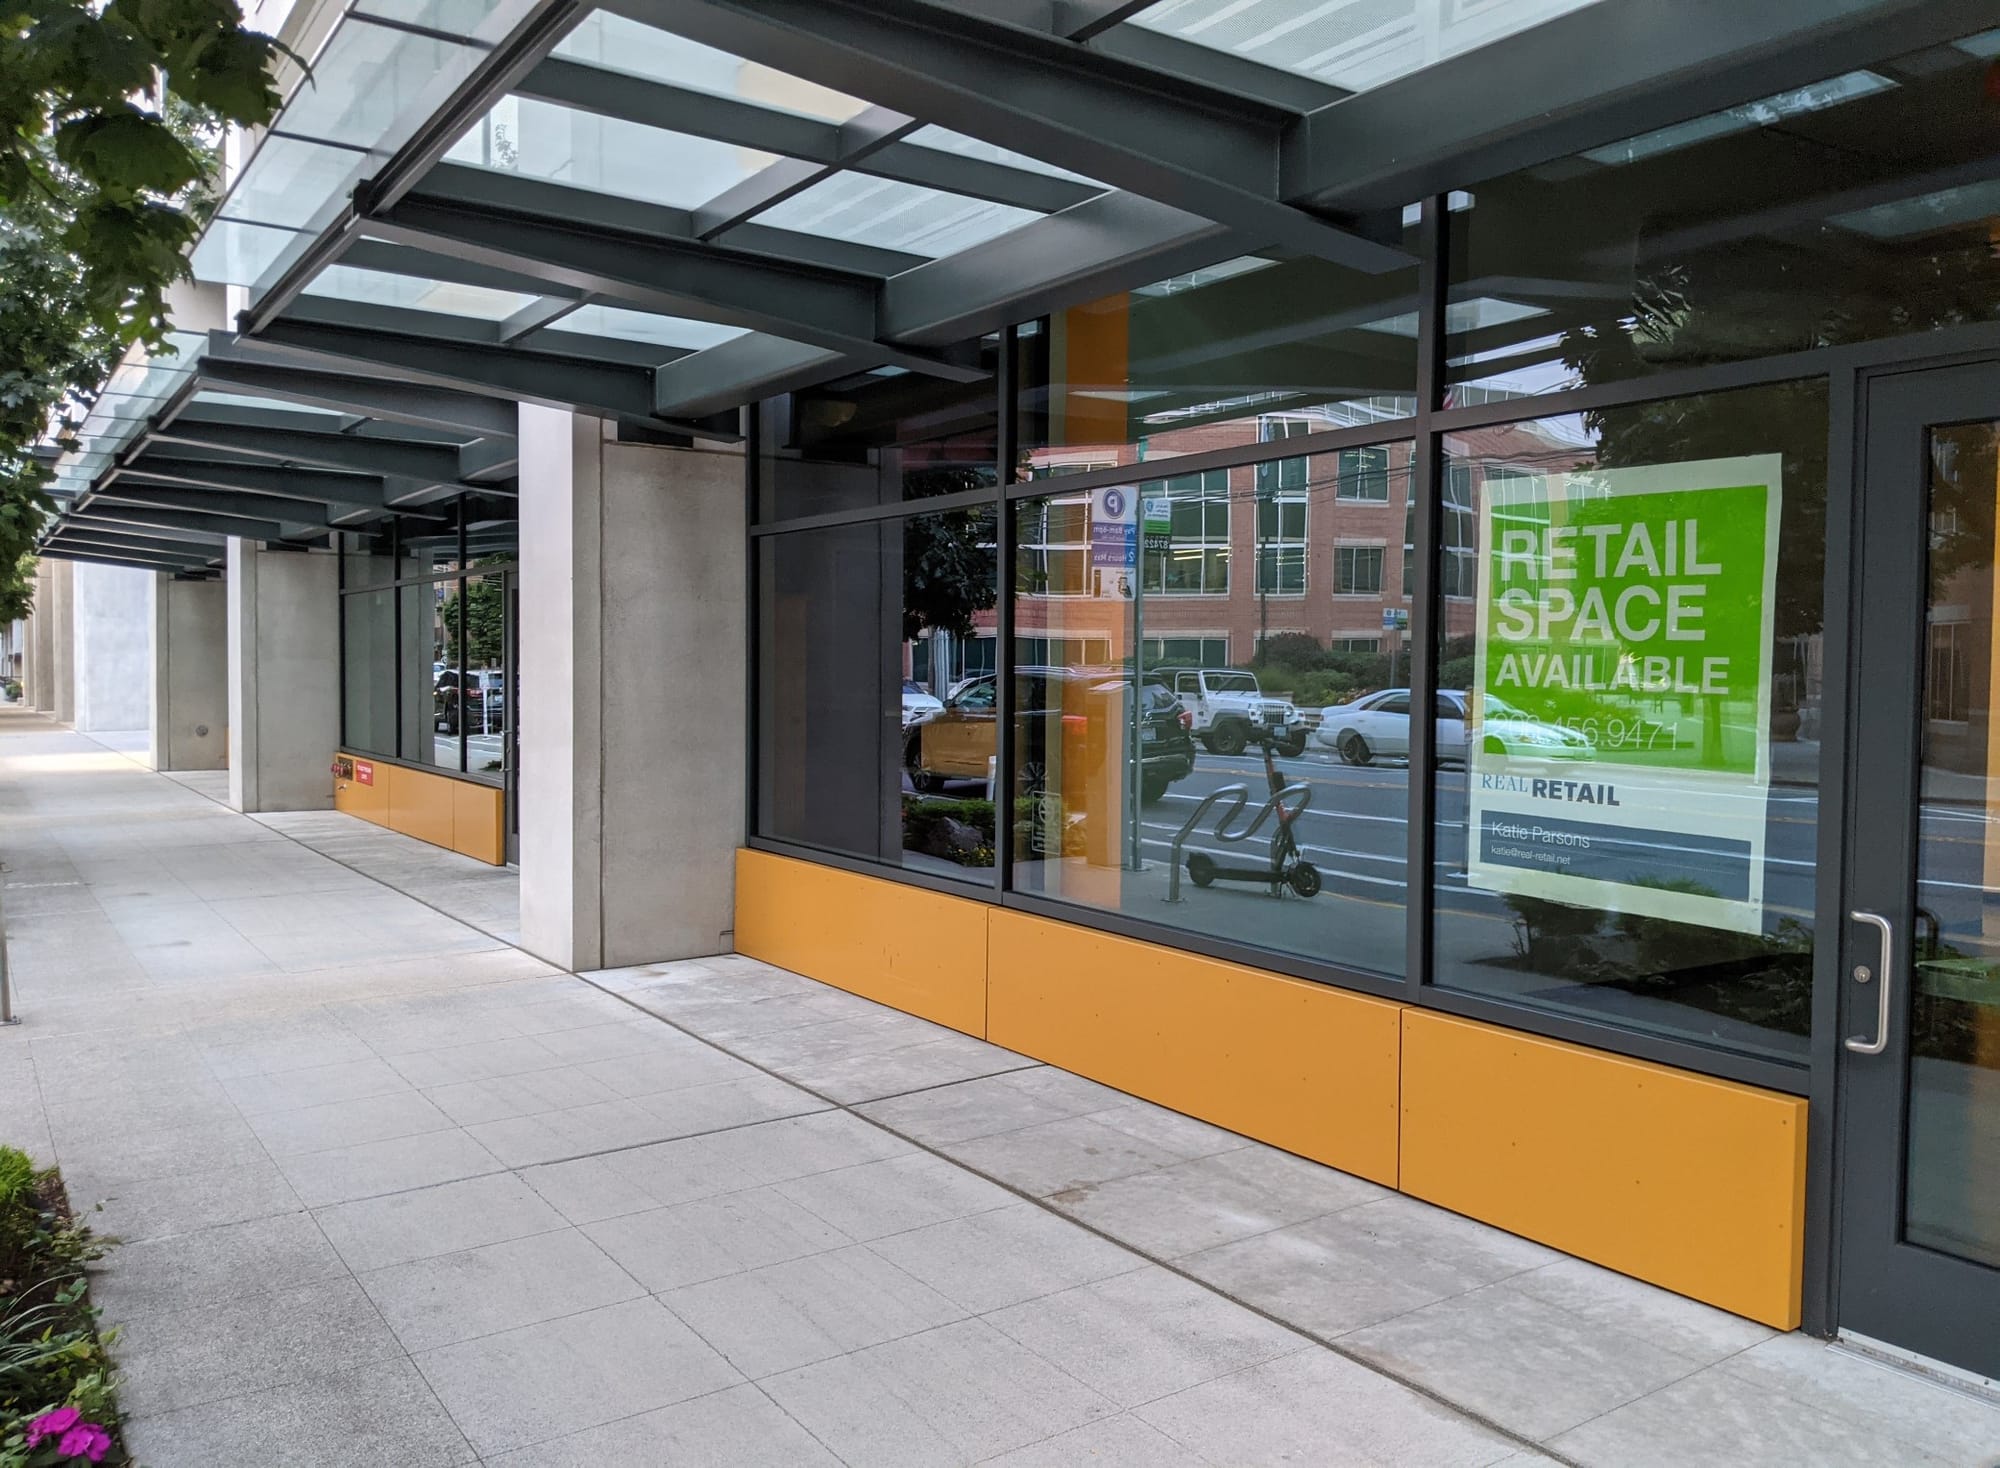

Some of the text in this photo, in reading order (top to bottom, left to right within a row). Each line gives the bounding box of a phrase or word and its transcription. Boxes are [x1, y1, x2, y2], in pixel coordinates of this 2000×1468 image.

[1501, 519, 1722, 581] RETAIL
[1496, 584, 1707, 642] SPACE
[1494, 653, 1730, 695] AVAILABLE
[1494, 712, 1678, 751] 456.9471
[1481, 773, 1620, 806] REAL RETAIL
[1491, 821, 1590, 848] Katie Parsons
[1491, 845, 1571, 865] katie@real-retail.net
